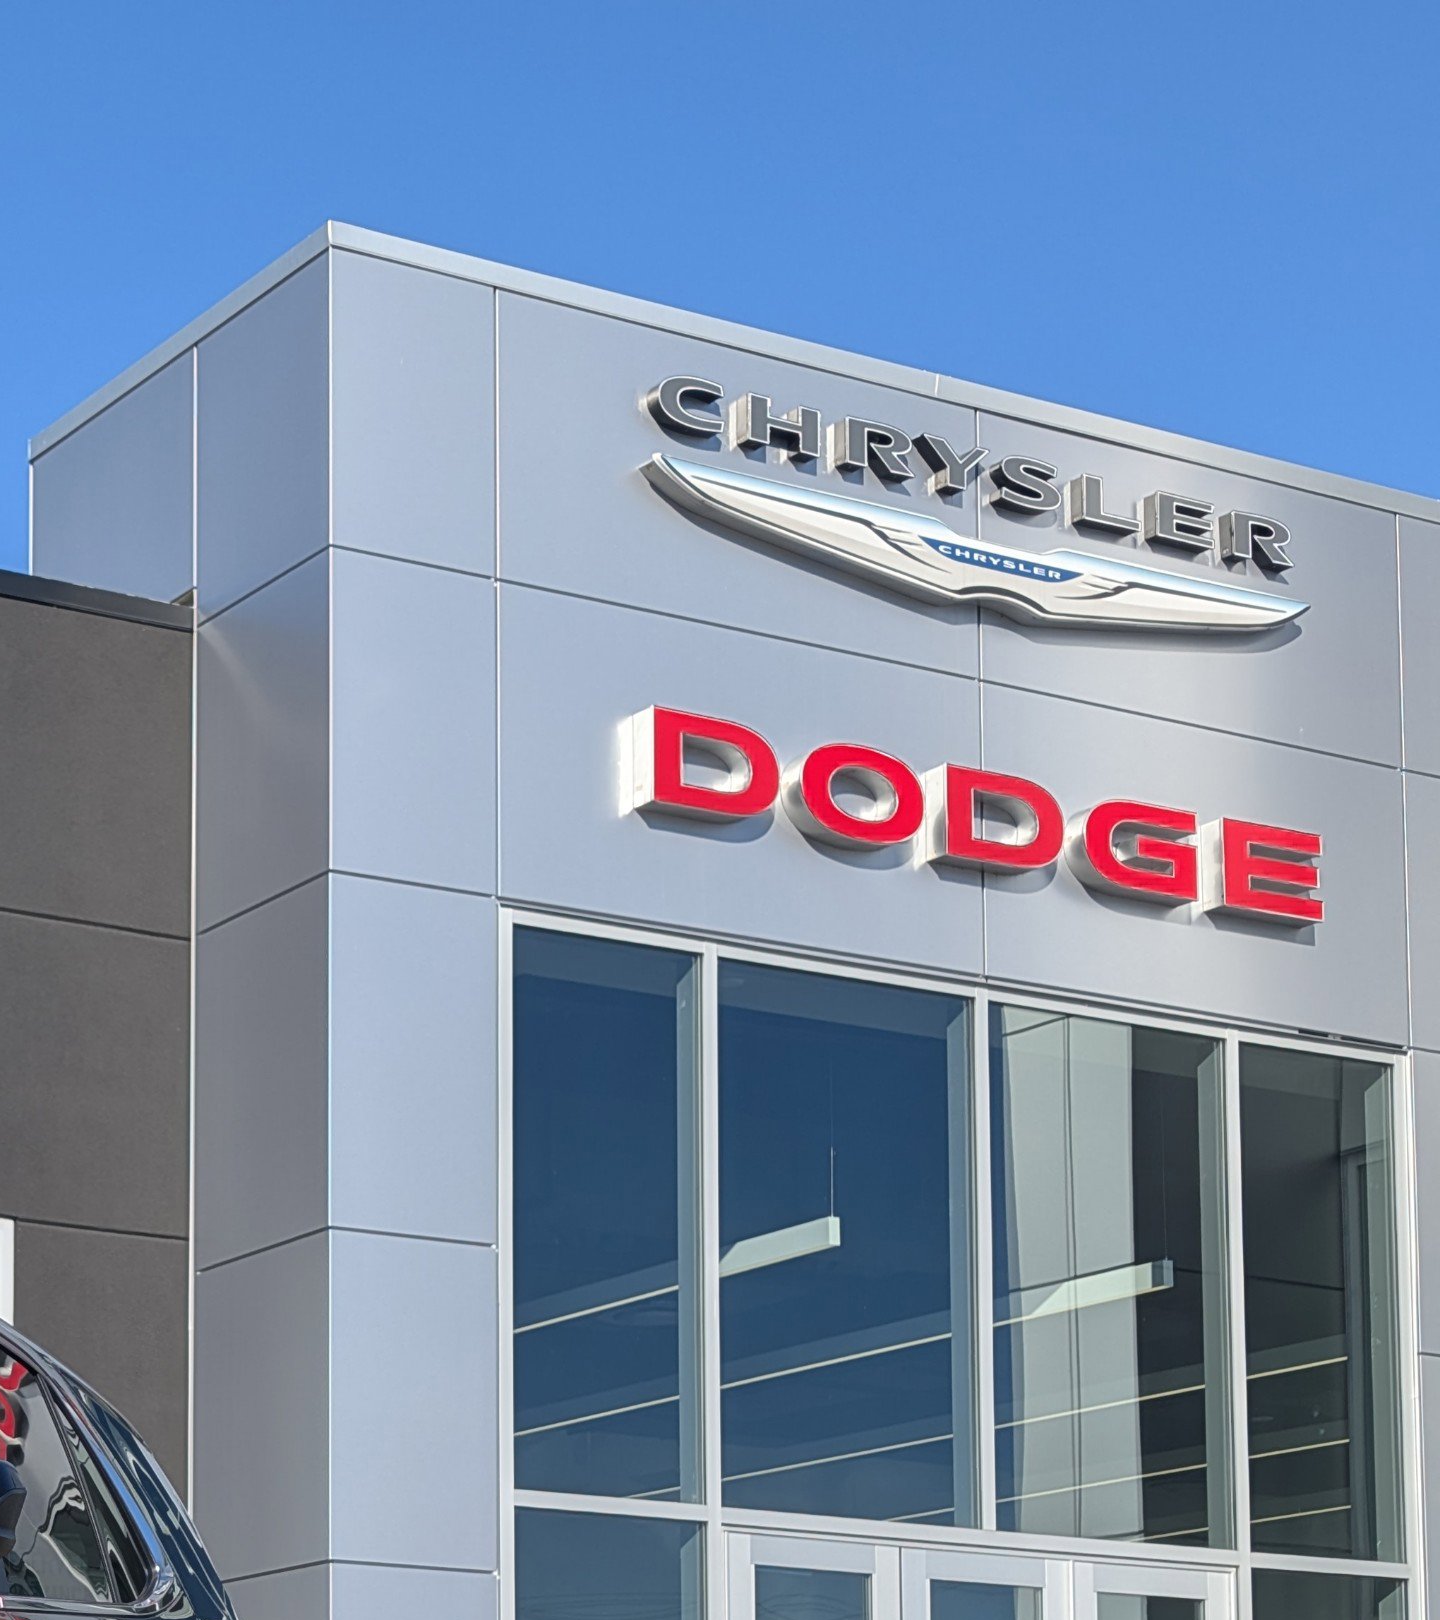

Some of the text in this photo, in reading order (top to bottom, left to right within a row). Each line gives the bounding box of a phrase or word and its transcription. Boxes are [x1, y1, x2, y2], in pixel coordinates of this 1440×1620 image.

[645, 375, 1294, 572] CHRYSLER
[937, 544, 1062, 580] CHRYSLER
[623, 704, 1325, 926] DODGE
